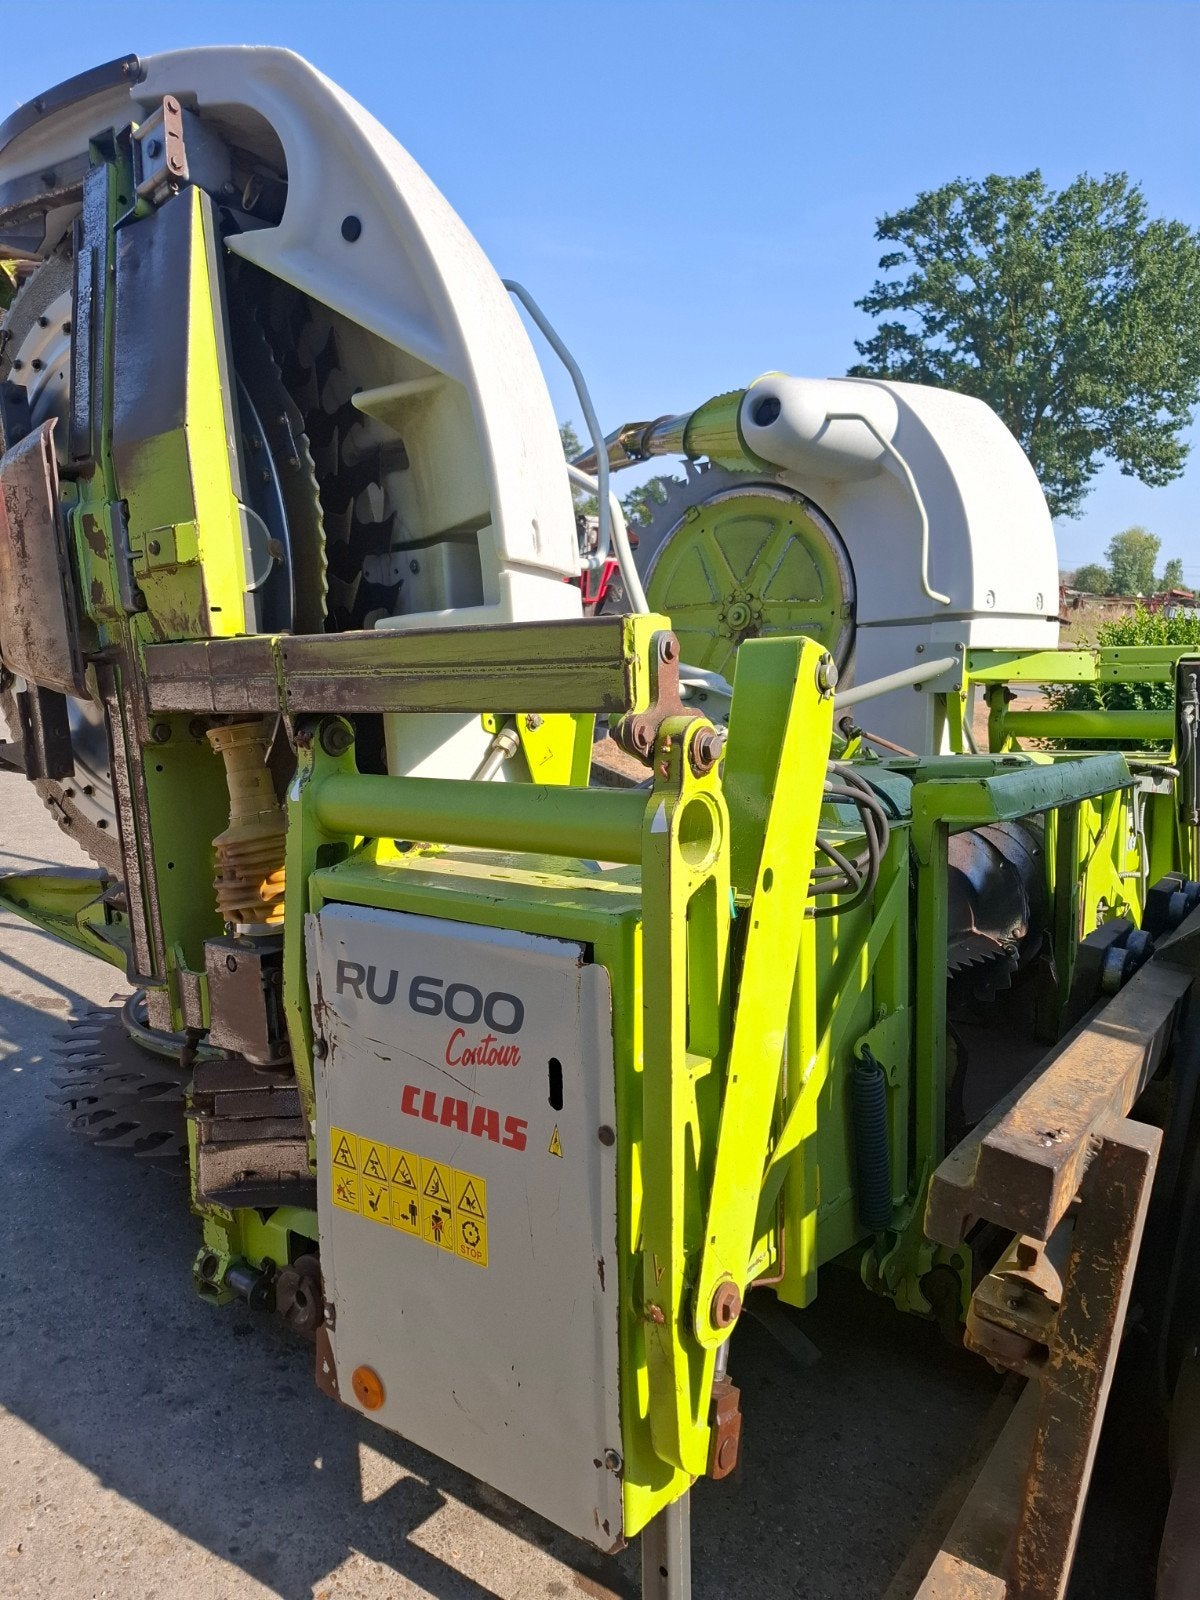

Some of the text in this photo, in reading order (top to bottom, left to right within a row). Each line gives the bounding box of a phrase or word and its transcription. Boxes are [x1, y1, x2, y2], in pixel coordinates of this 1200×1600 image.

[336, 959, 525, 1035] RU 600
[445, 1028, 520, 1067] Contour
[400, 1084, 528, 1152] CLAAS
[461, 1244, 482, 1259] STOP
